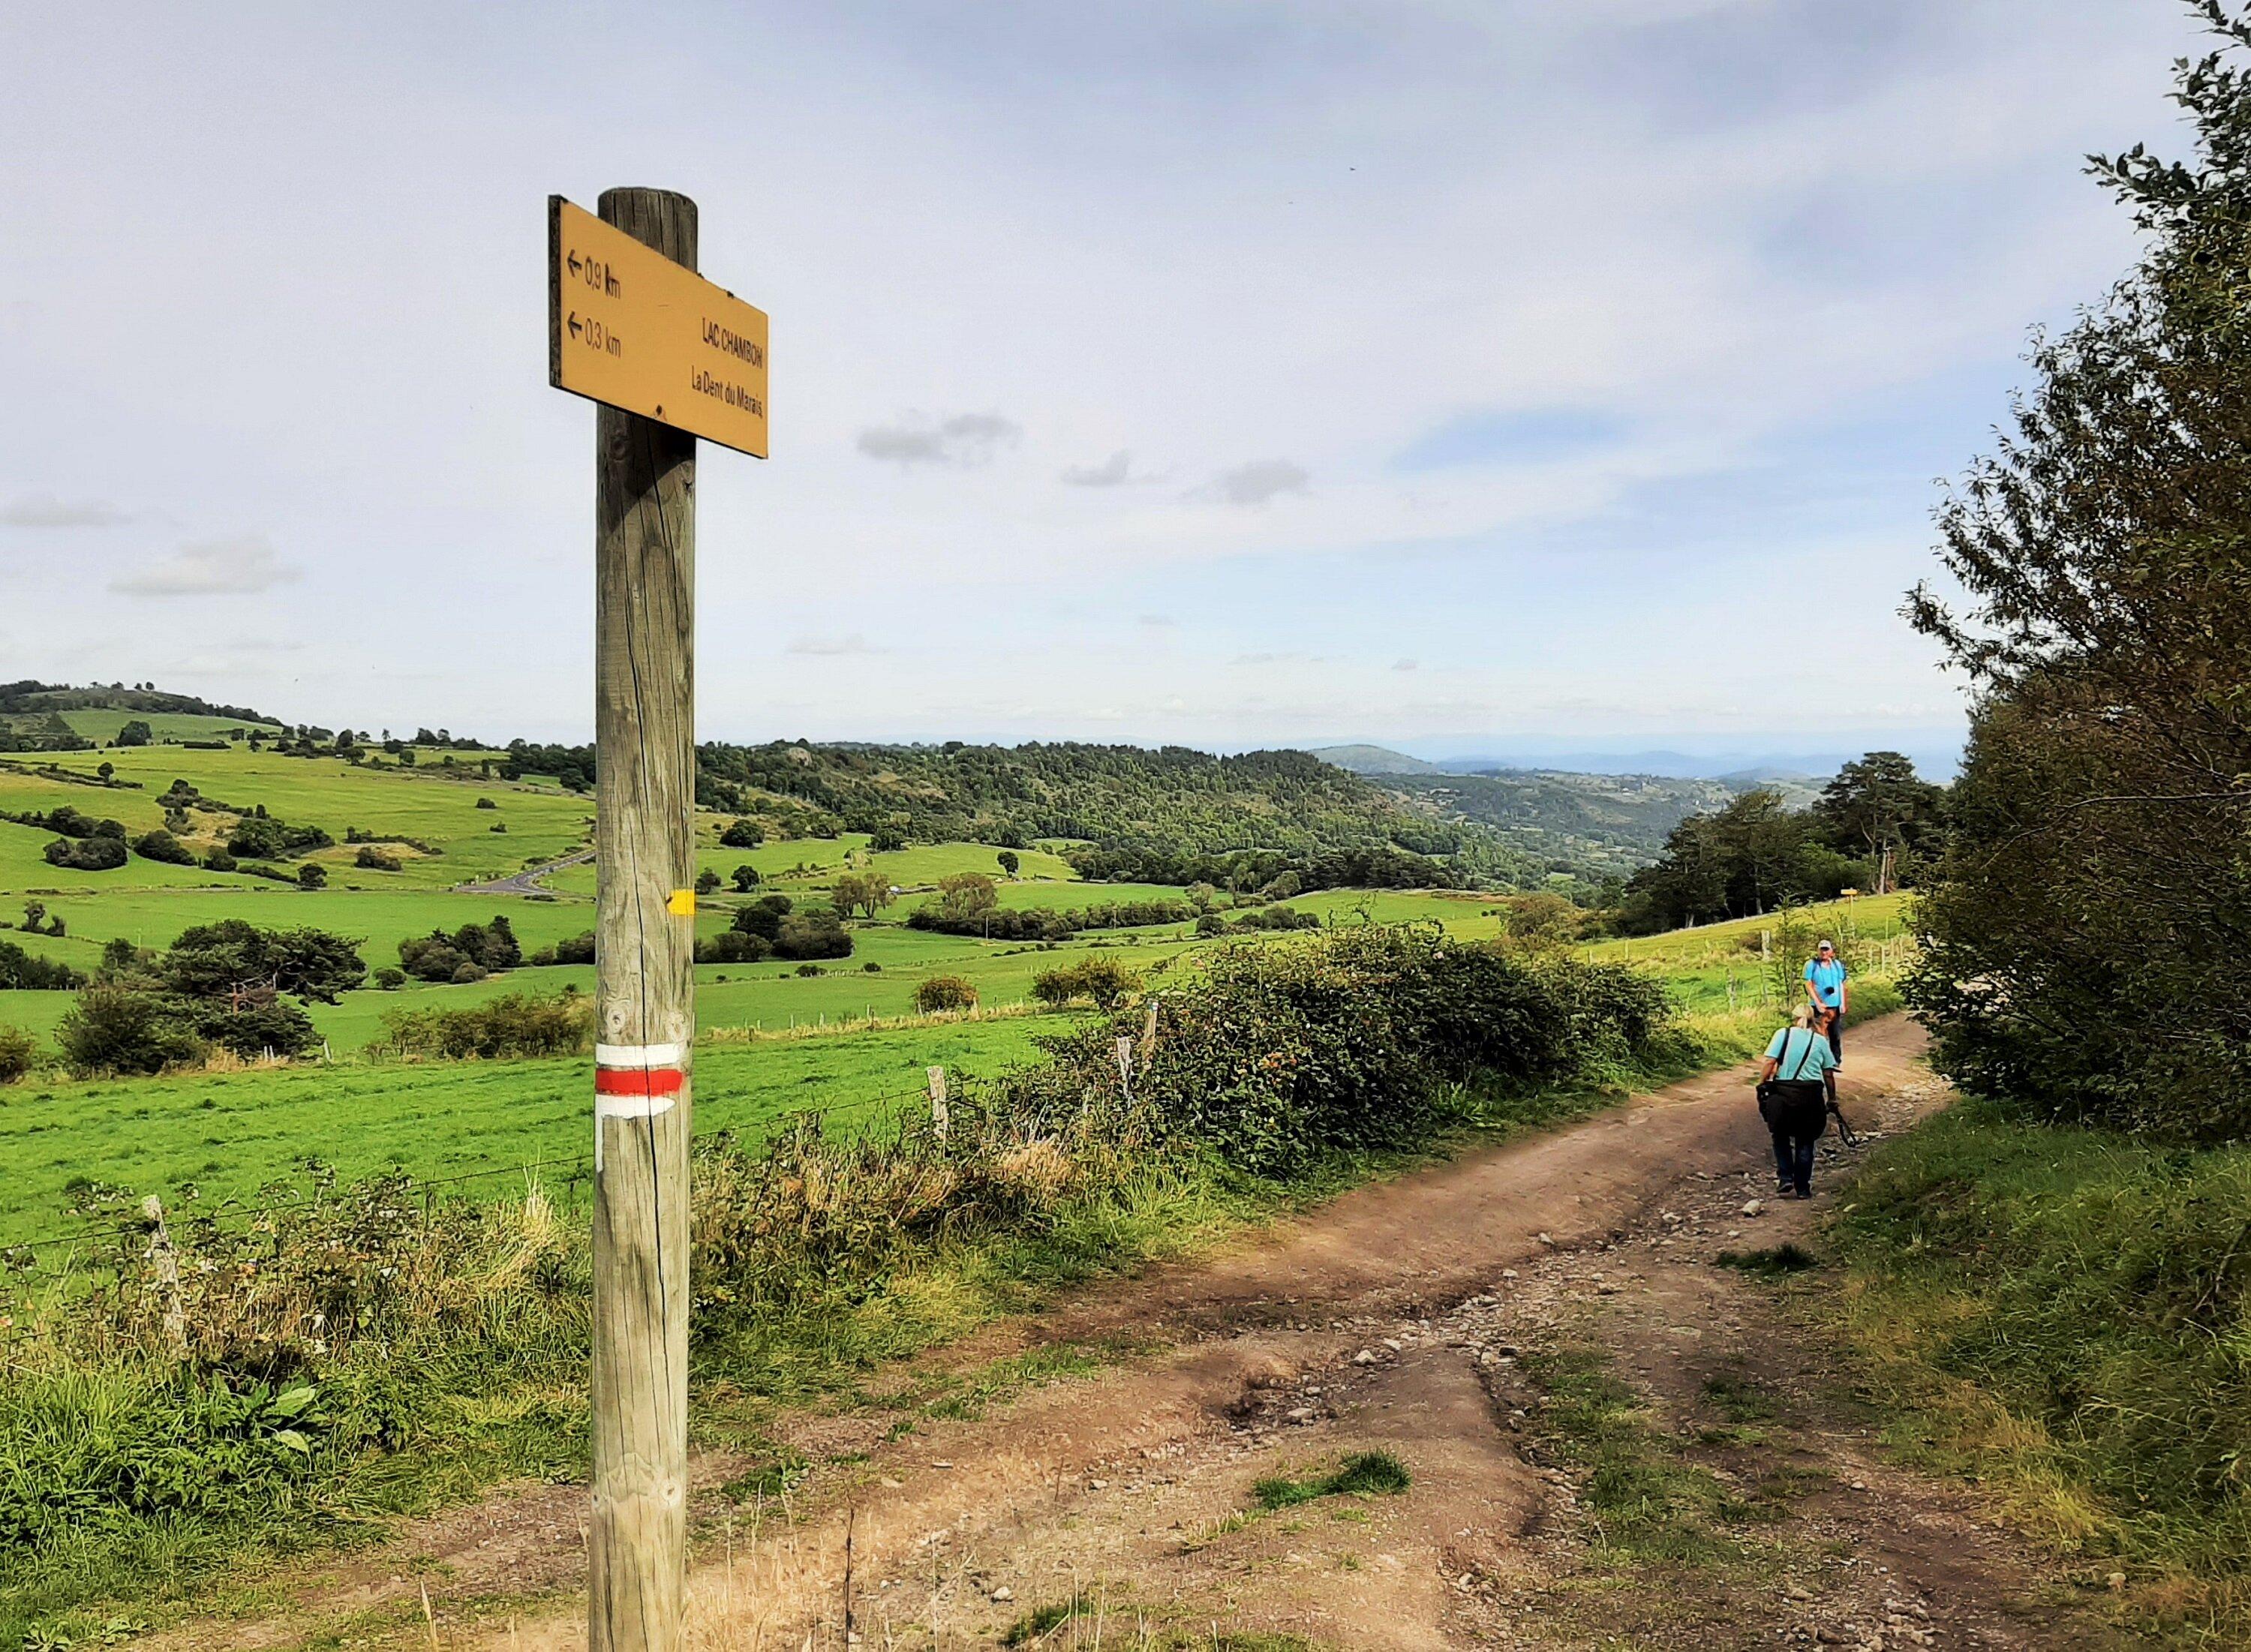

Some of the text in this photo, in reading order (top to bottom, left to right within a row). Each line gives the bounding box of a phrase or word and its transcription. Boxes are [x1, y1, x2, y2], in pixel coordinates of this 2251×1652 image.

[585, 256, 621, 299] 0,9 km
[585, 317, 621, 359] 0,3 km
[702, 317, 763, 369] LAC CHAMBON
[692, 365, 763, 419] La Dent du Marais
